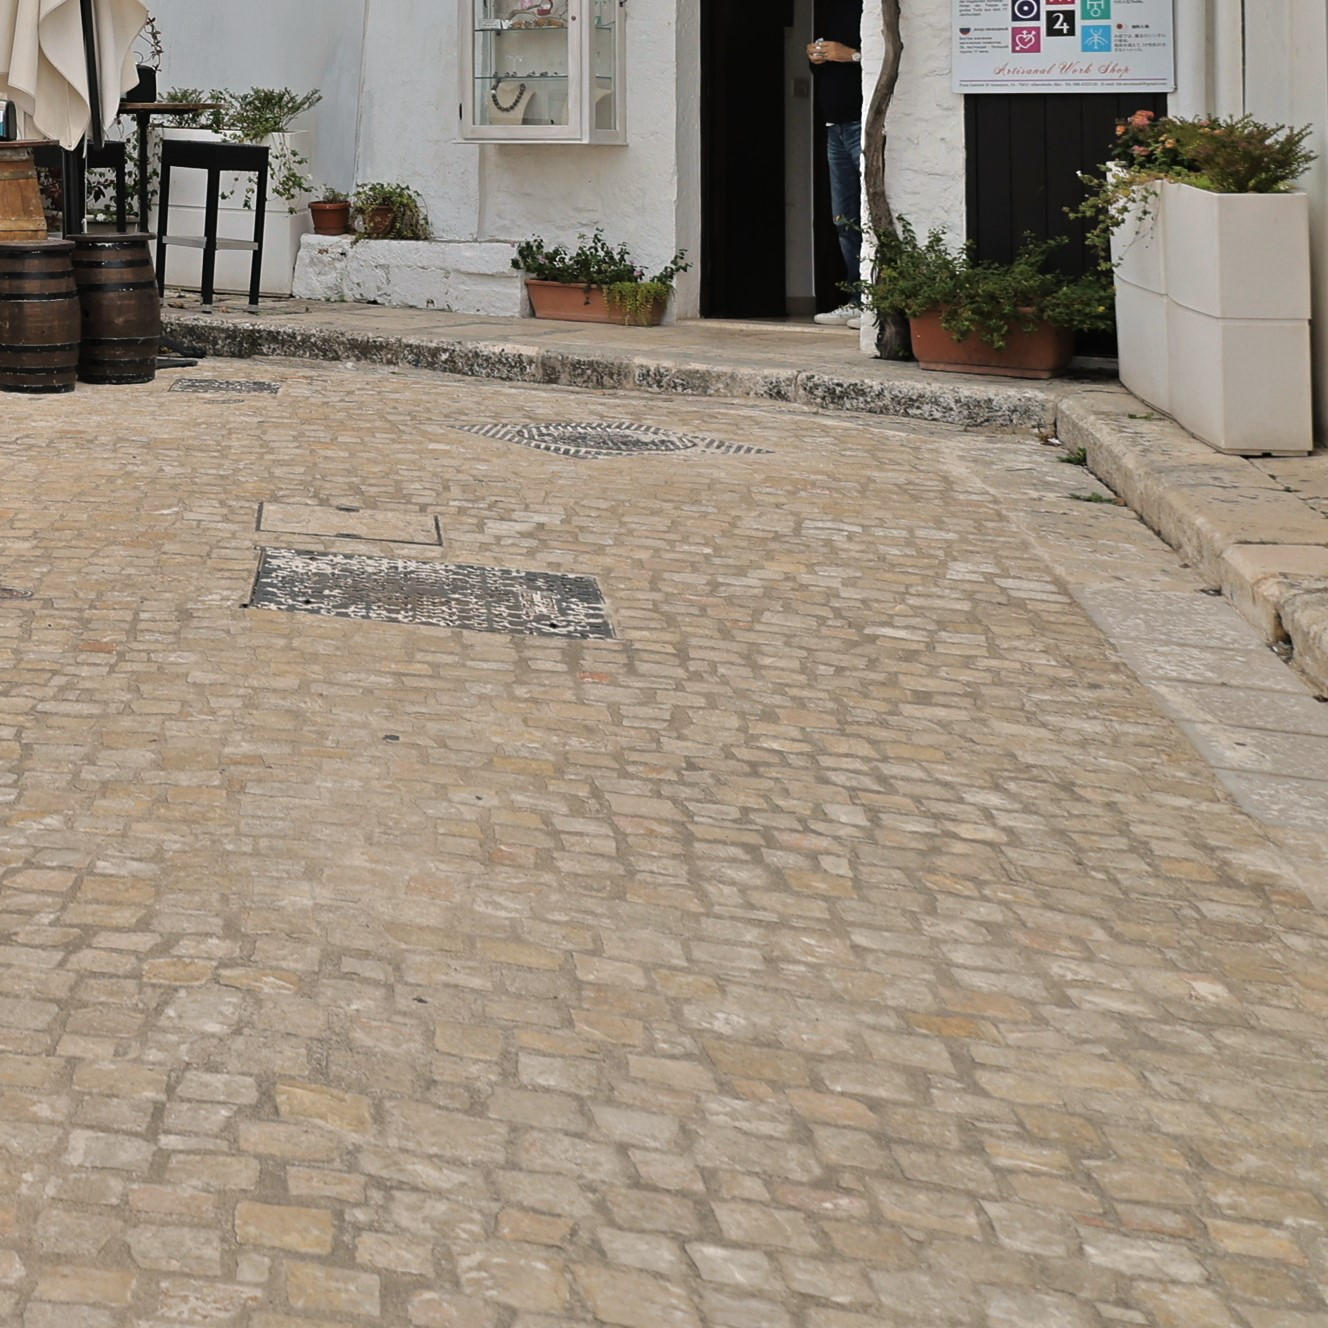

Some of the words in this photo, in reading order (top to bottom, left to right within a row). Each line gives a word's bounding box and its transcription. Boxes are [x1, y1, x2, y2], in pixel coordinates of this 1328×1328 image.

[993, 62, 1054, 76] Artisanal
[1057, 61, 1092, 75] Work
[1098, 61, 1131, 77] Shop
